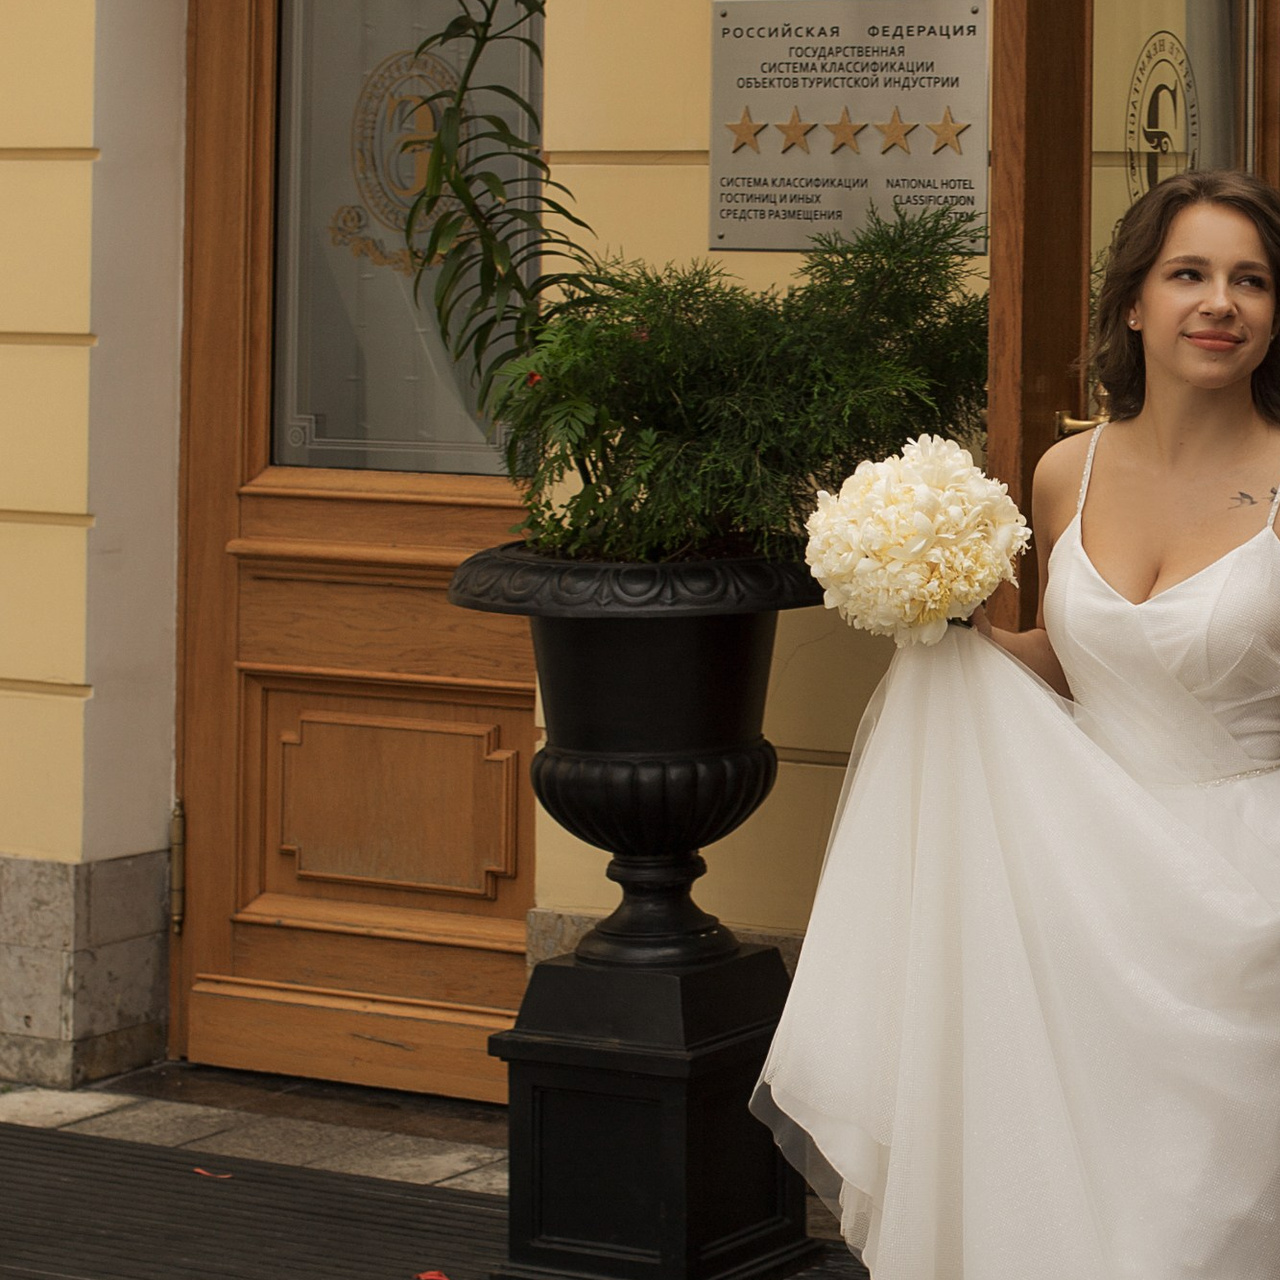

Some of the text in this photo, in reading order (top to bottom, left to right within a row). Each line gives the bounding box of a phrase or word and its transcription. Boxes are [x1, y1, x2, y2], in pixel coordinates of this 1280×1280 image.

[721, 23, 978, 40] РОССИЙСКАЯ ФЕДЕРАЦИЯ
[788, 46, 906, 61] ГОСУДАРСТВЕННАЯ
[760, 61, 935, 76] СИСТЕМА КЛАССИФИКАЦИИ
[736, 74, 960, 91] ОБЪЕКТОВ ТУРИСТСКОЙ ИНДУСТРИИ
[719, 177, 869, 191] СИСТЕМА КЛАССИФИКАЦИИ
[886, 178, 975, 190] NATIONAL HOTEL
[719, 193, 822, 206] ГОСТИНИЦ И ИНЫХ
[893, 195, 975, 206] CLASSIFICATION
[719, 209, 843, 223] СРЕДСТВ РАЗМЕЩЕНИЯ
